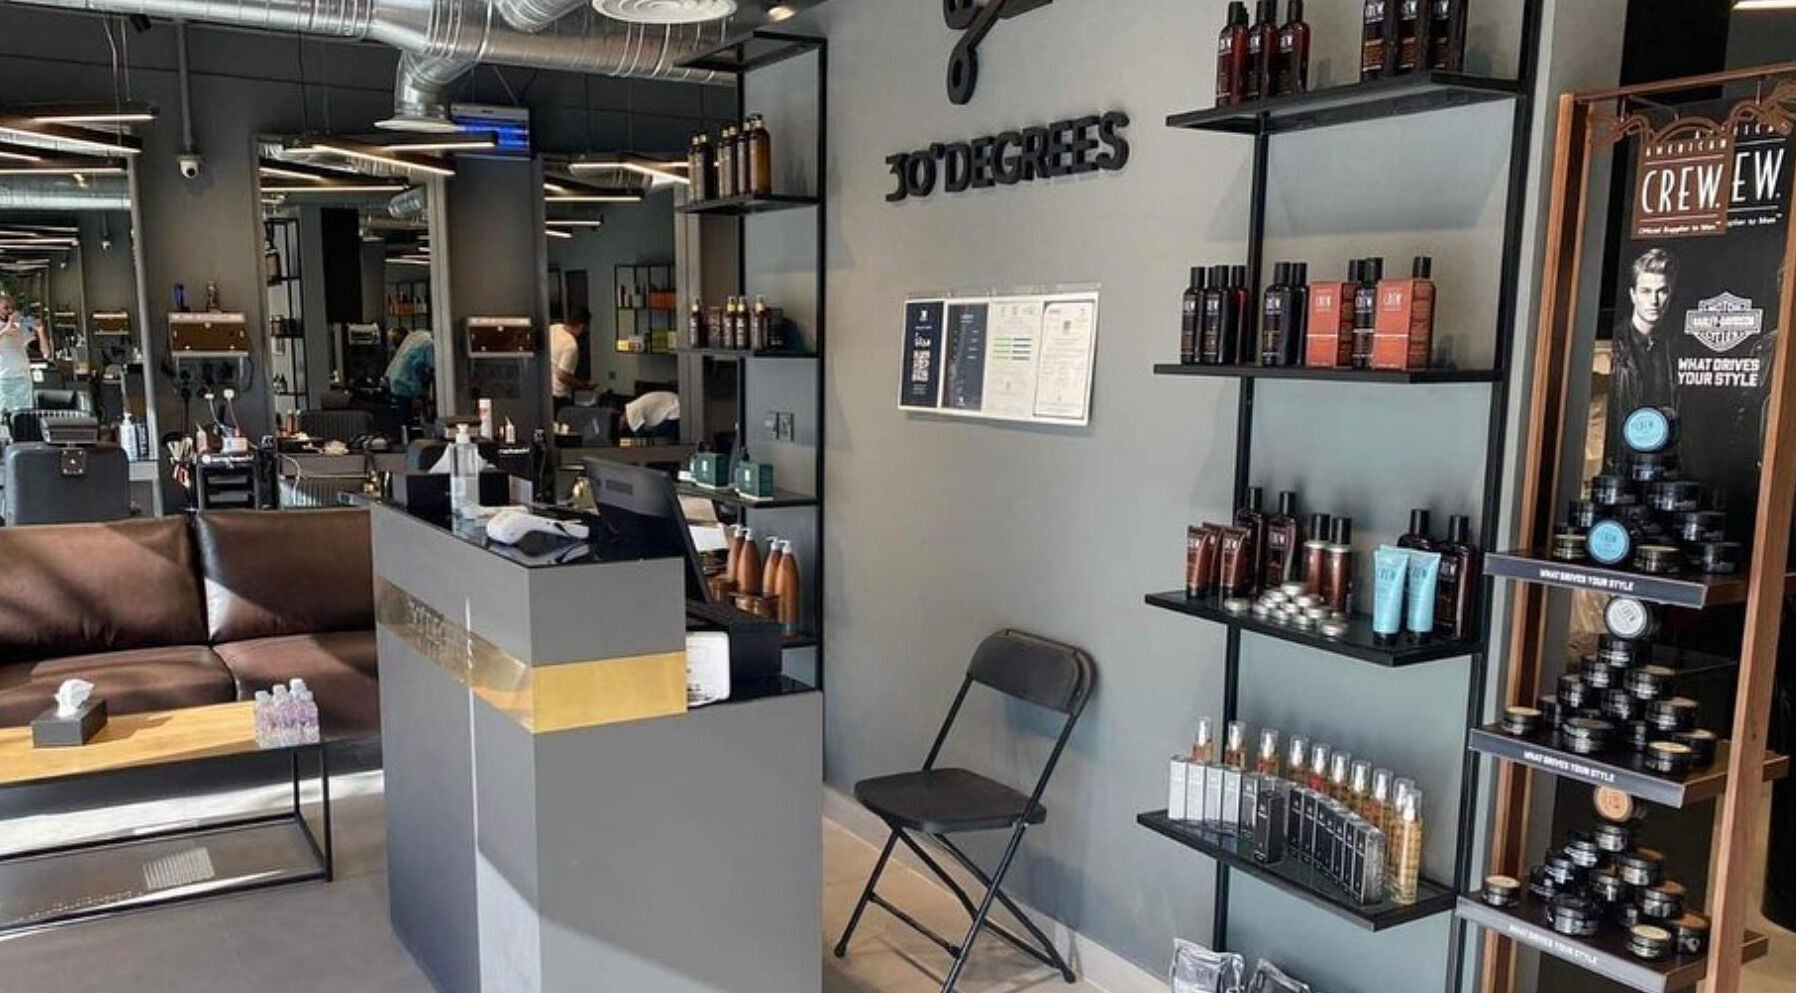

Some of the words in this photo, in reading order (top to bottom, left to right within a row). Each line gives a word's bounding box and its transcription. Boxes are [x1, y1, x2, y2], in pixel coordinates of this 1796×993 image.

[1678, 358, 1713, 371] WHAT
[1713, 358, 1760, 371] DRIVES
[1678, 371, 1713, 385] YOUR
[1714, 371, 1758, 386] STYLE
